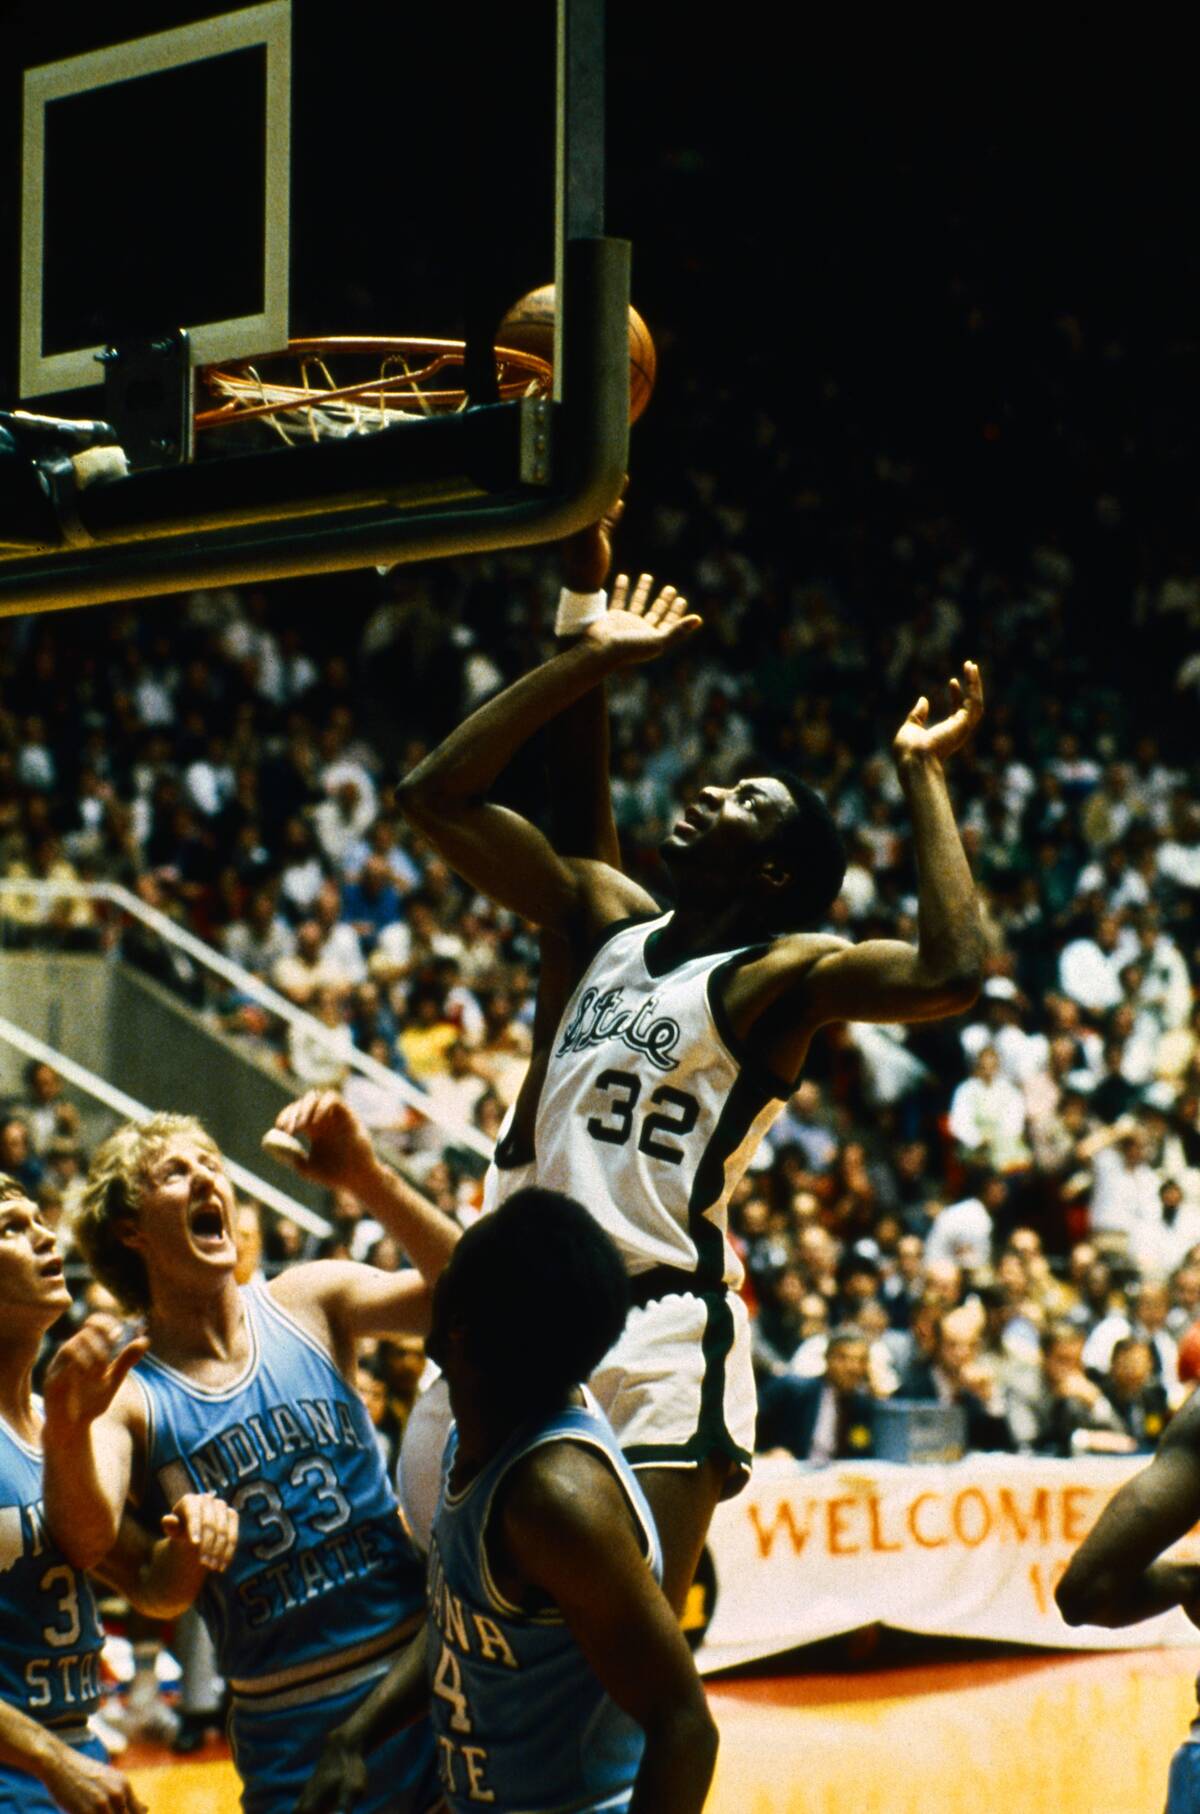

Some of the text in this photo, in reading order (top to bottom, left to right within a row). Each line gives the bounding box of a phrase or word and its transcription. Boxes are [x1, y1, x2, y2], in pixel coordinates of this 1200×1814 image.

[555, 985, 680, 1072] State
[587, 1068, 700, 1166] 32
[231, 1454, 352, 1561] 33
[747, 1485, 1098, 1560] WELCOME
[238, 1522, 388, 1627] STATE
